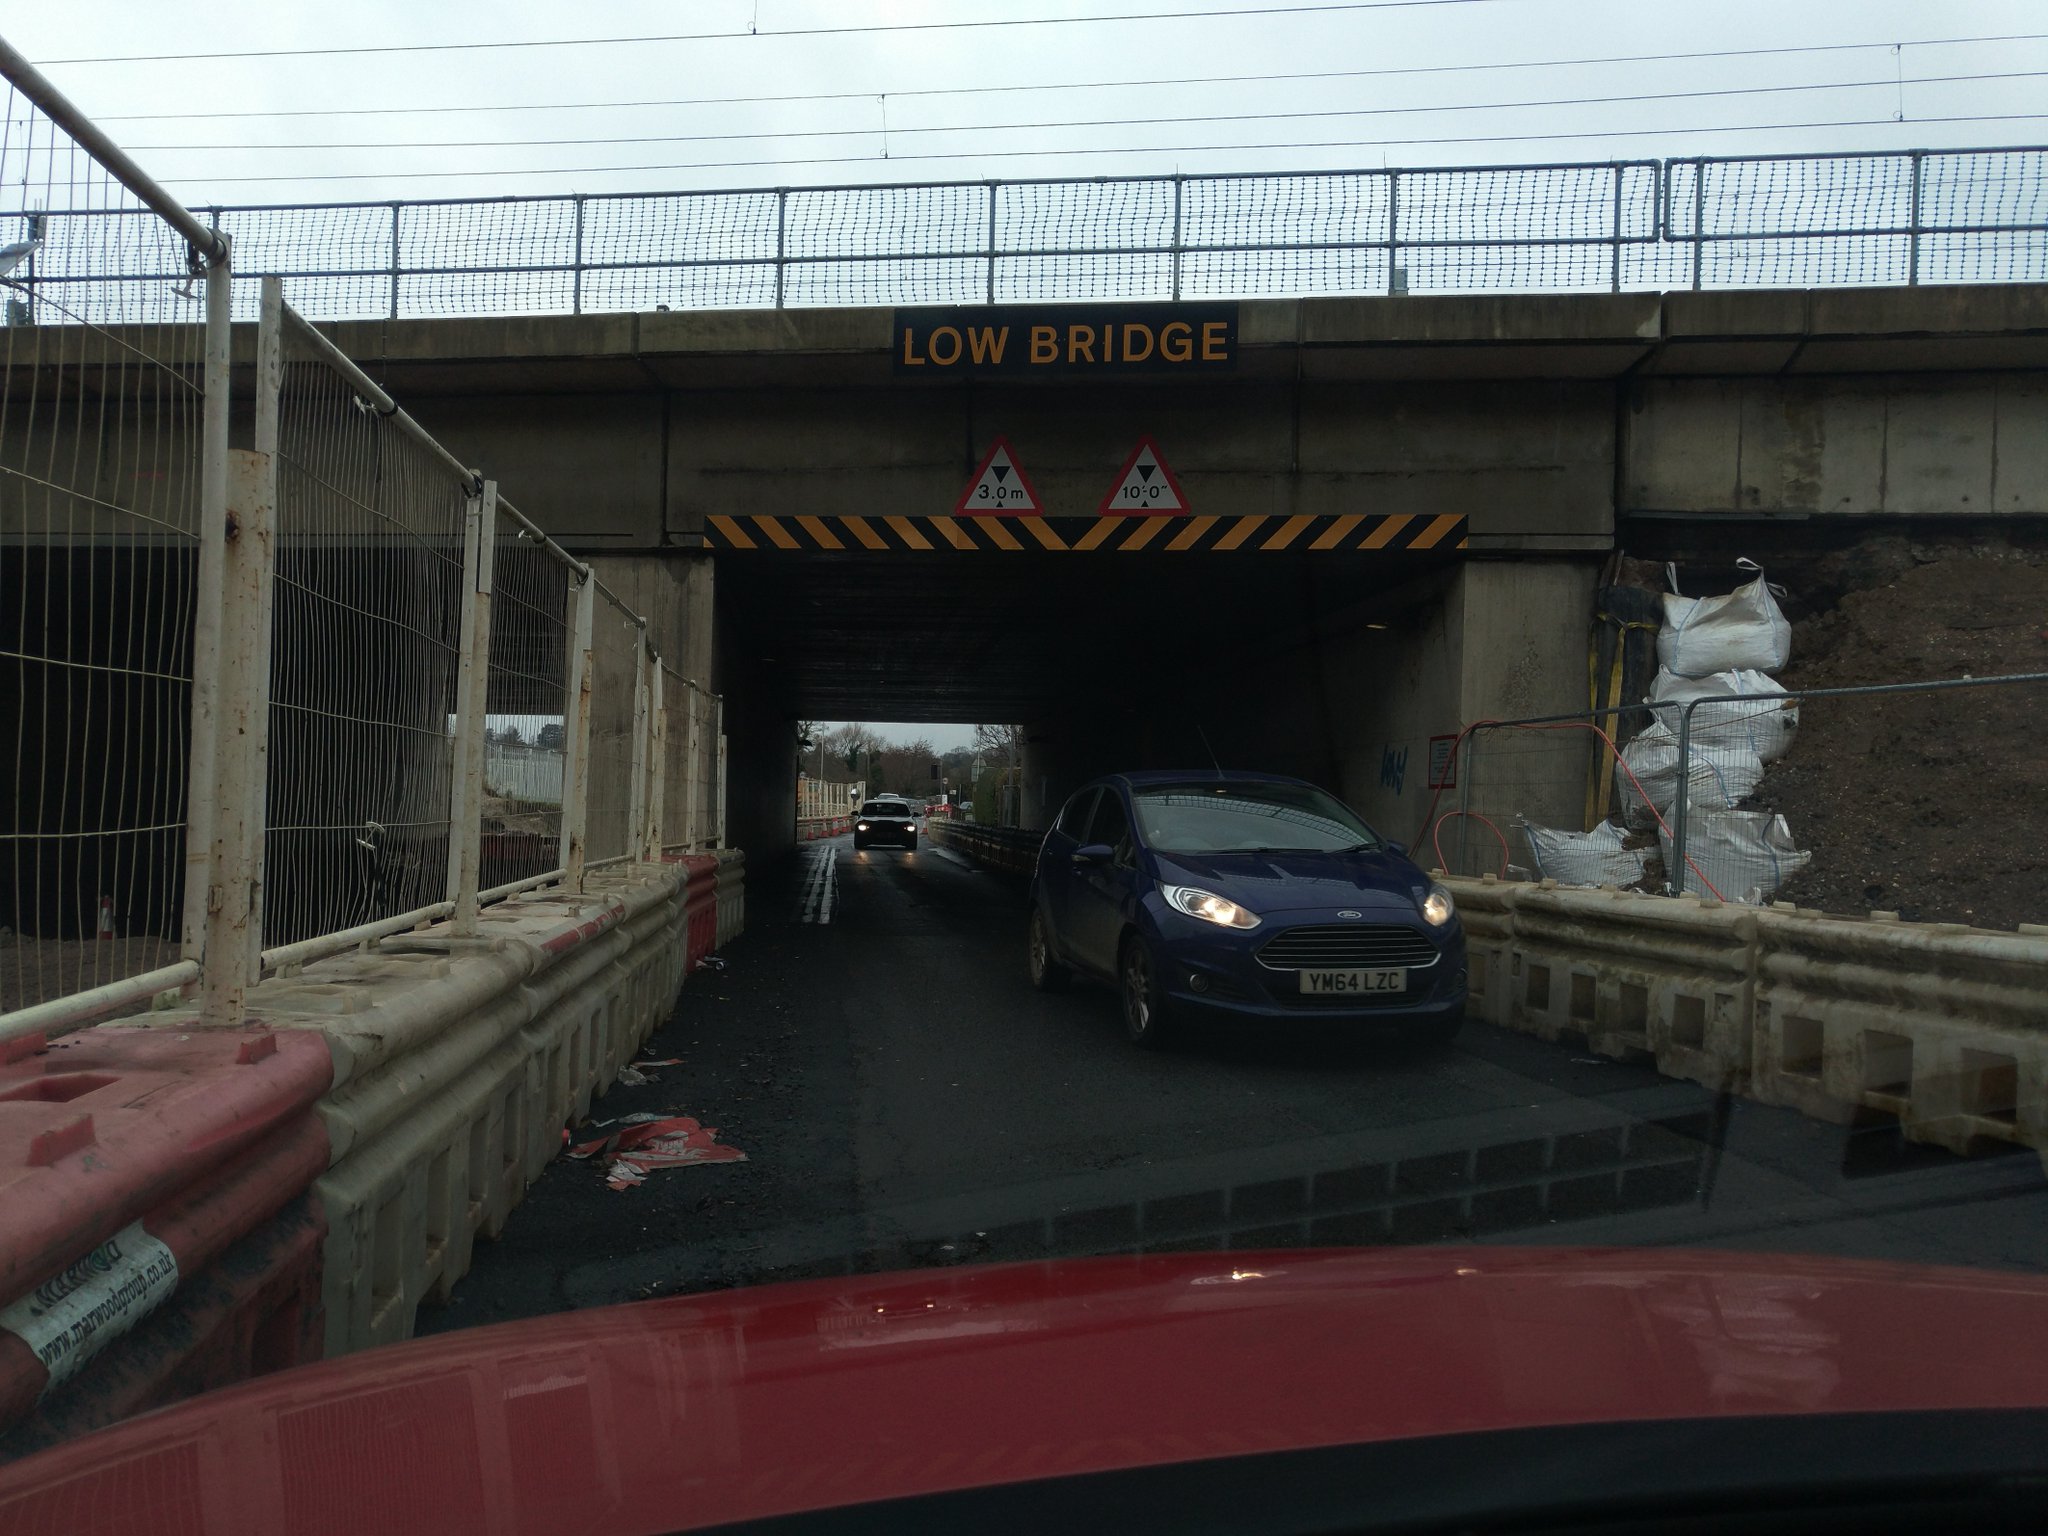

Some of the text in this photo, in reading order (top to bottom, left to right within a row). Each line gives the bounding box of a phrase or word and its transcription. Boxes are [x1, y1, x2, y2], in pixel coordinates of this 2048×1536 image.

[903, 321, 1229, 366] LOW BRIDGE
[1309, 972, 1400, 991] YM64 LZC
[38, 1250, 176, 1366] www.marwoodgroup.co.uk
